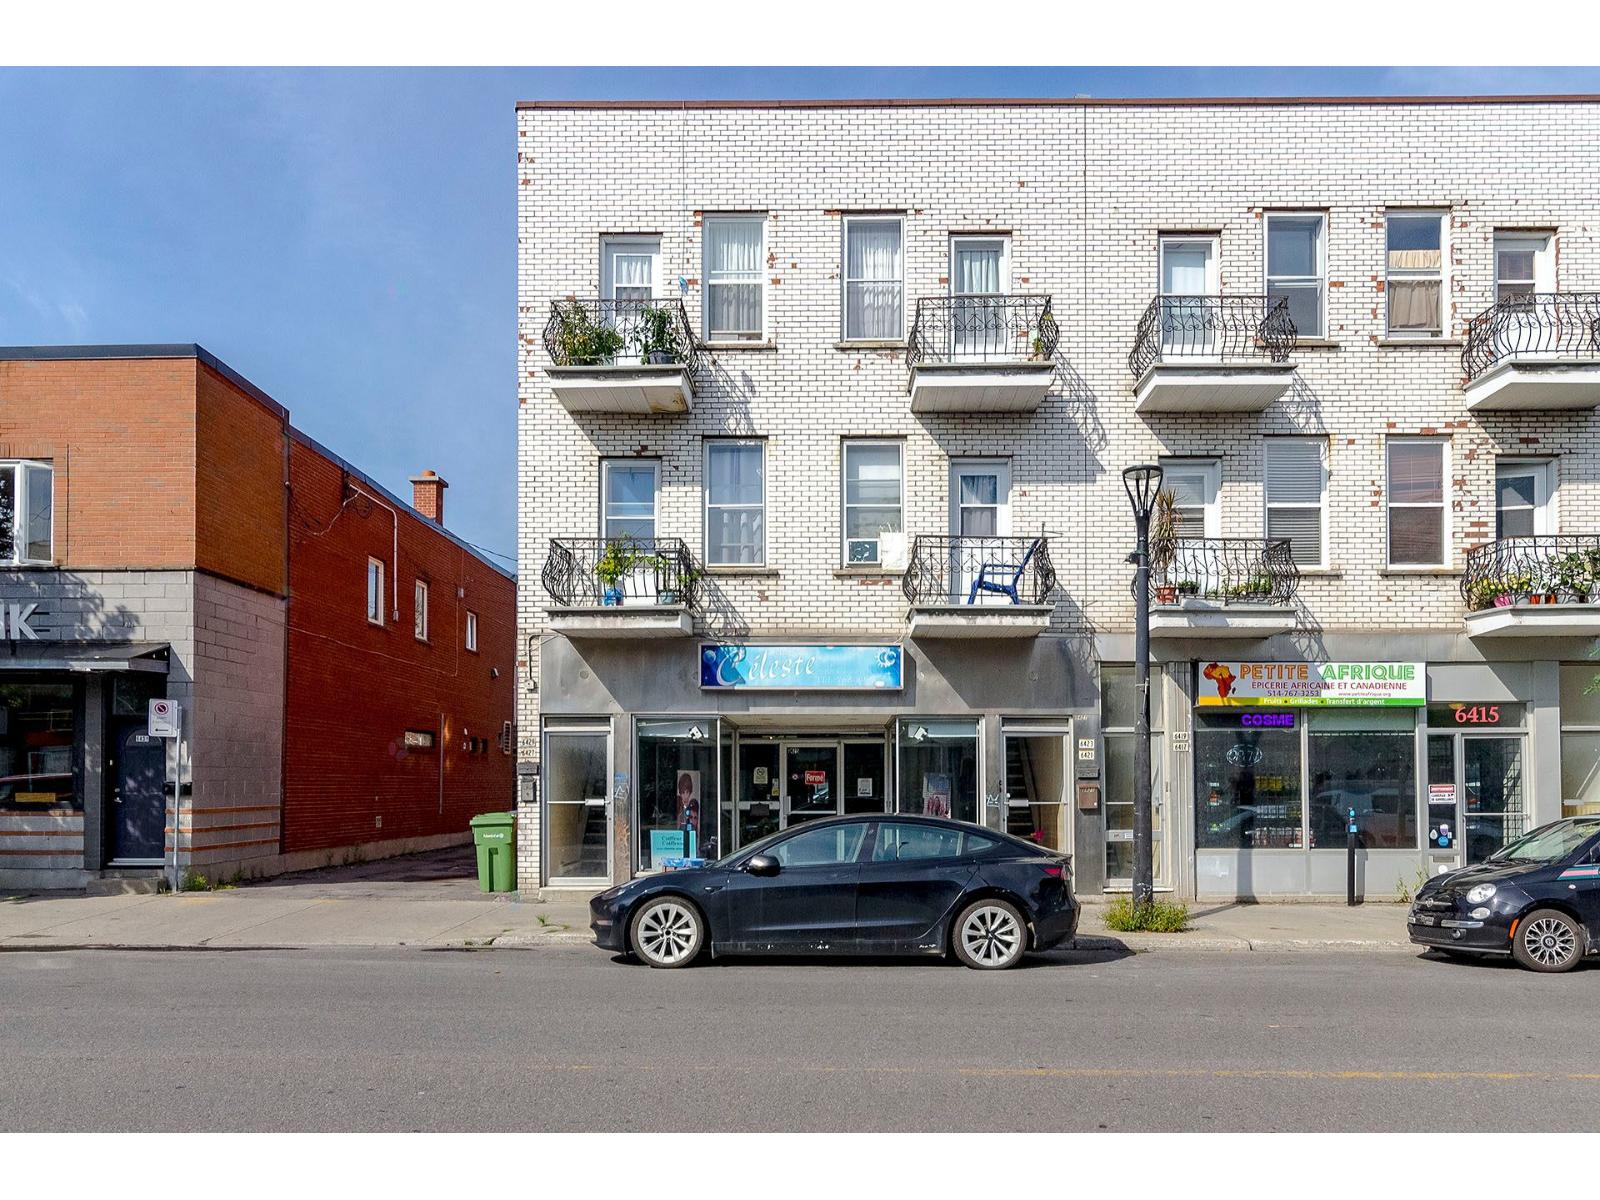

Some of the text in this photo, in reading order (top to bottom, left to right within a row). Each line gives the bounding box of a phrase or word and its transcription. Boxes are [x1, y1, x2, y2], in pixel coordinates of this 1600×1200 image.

[1240, 664, 1415, 681] PETITE AFRIQUE
[1251, 681, 1407, 690] EPICERIE AFRICAINE ET CANADIENNE
[1263, 697, 1282, 705] Fruits
[1289, 697, 1319, 705] Grillades
[1241, 714, 1294, 726] COSME
[1455, 706, 1499, 723] 6415
